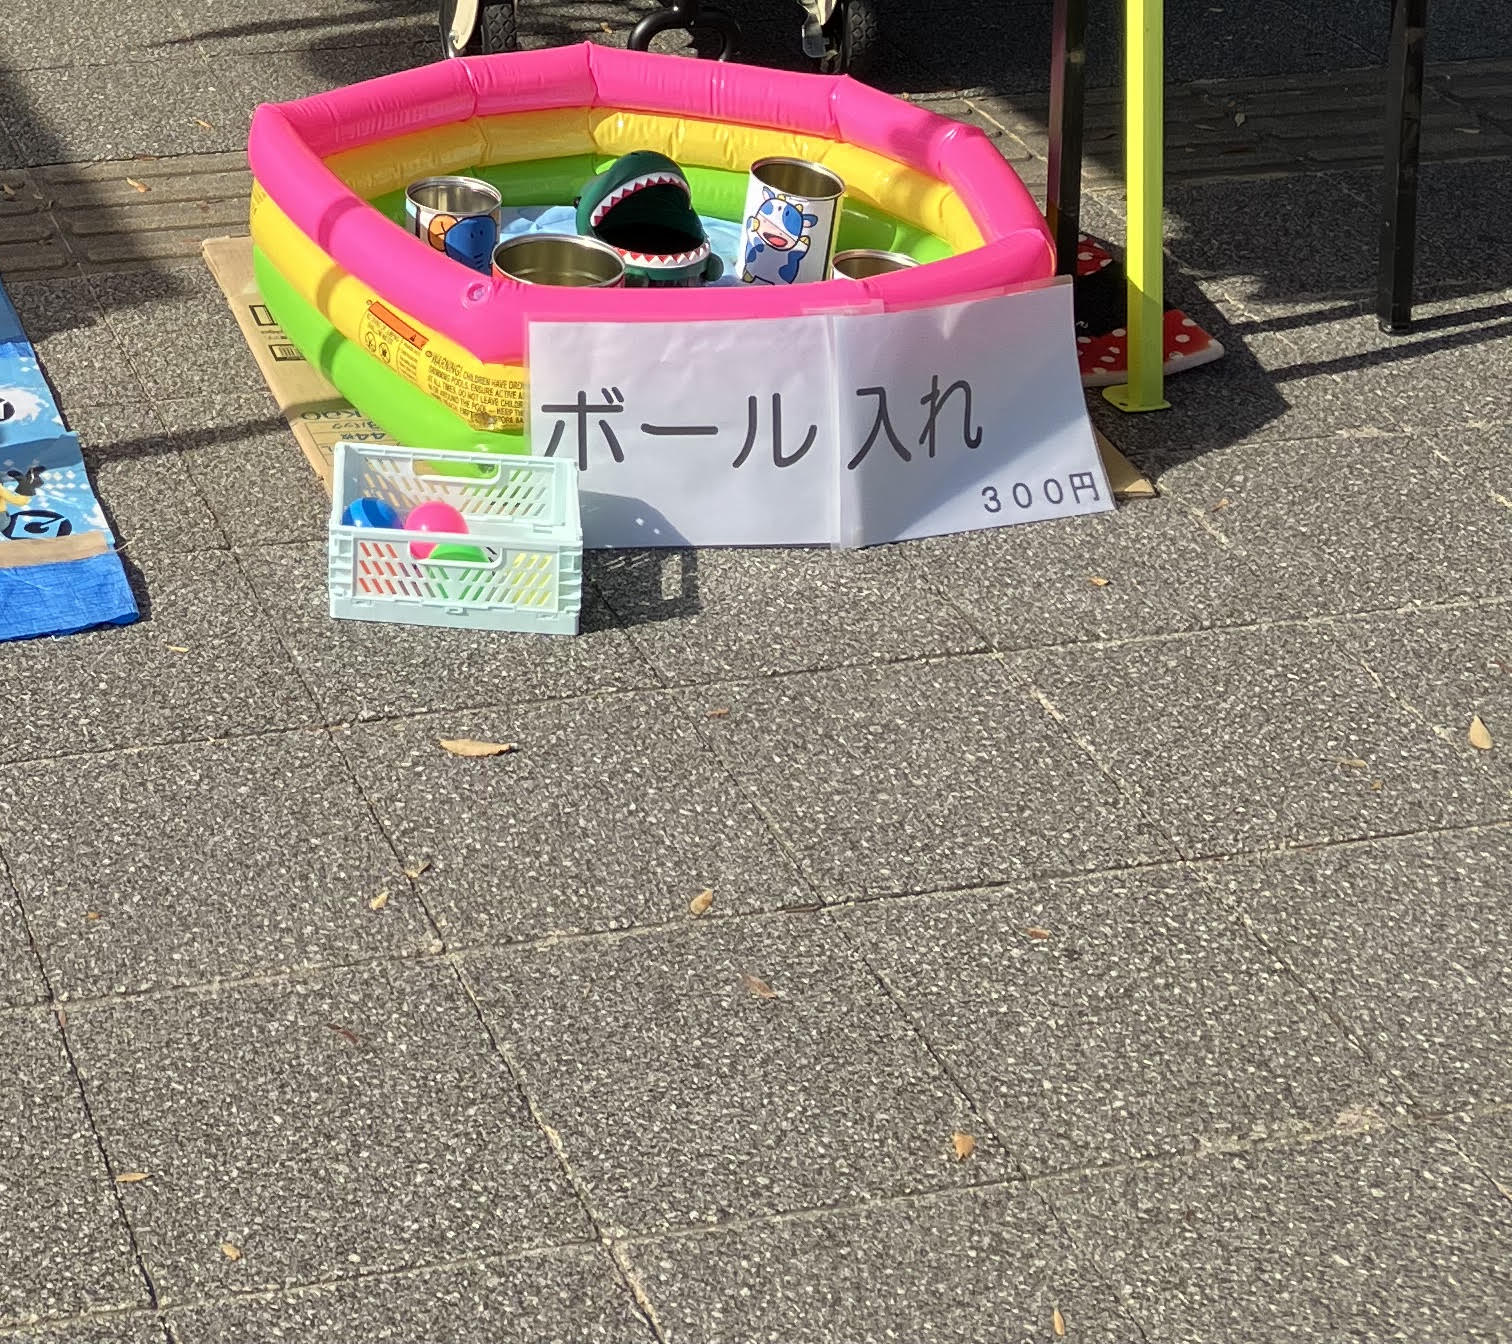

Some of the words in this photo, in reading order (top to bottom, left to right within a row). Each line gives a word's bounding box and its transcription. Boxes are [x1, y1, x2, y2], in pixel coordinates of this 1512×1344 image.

[541, 375, 982, 471] ボール入れ
[981, 472, 1100, 514] 300円
